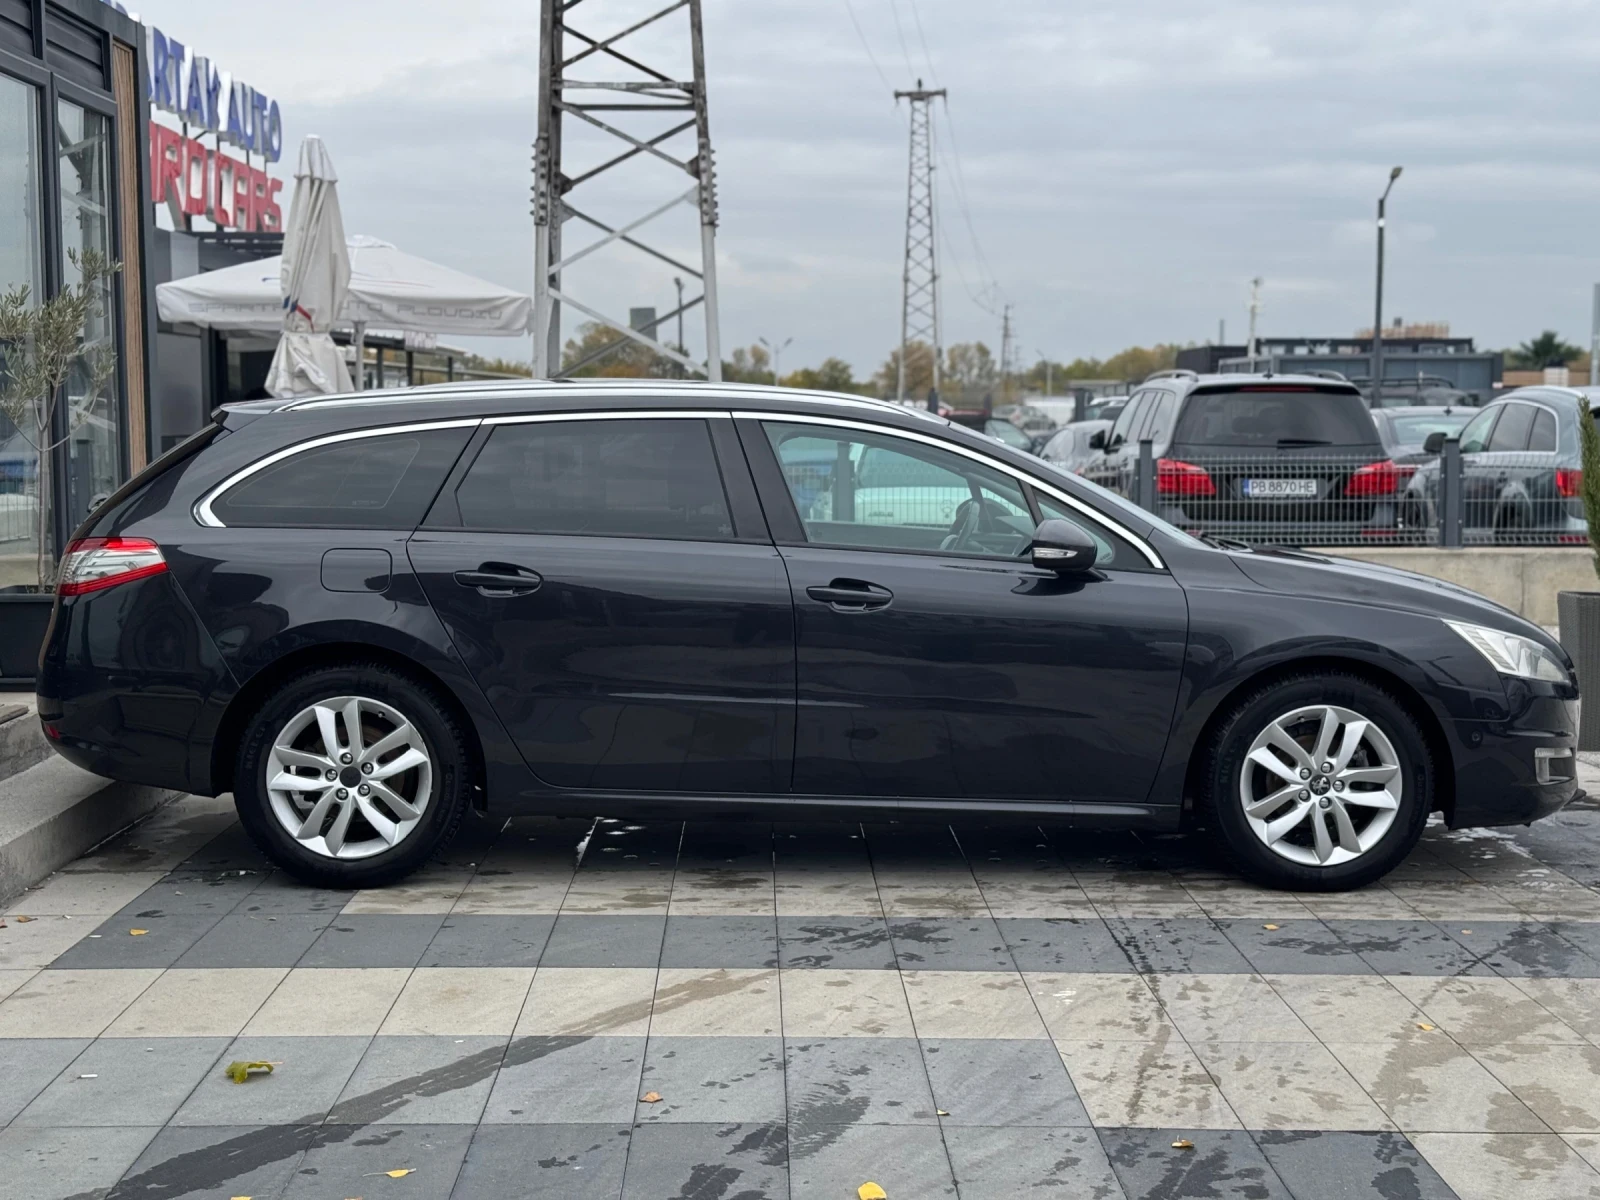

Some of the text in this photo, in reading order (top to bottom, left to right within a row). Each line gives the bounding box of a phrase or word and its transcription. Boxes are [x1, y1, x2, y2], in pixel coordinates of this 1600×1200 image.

[226, 77, 282, 163] AUTO
[1251, 481, 1314, 493] PB 8870 HE
